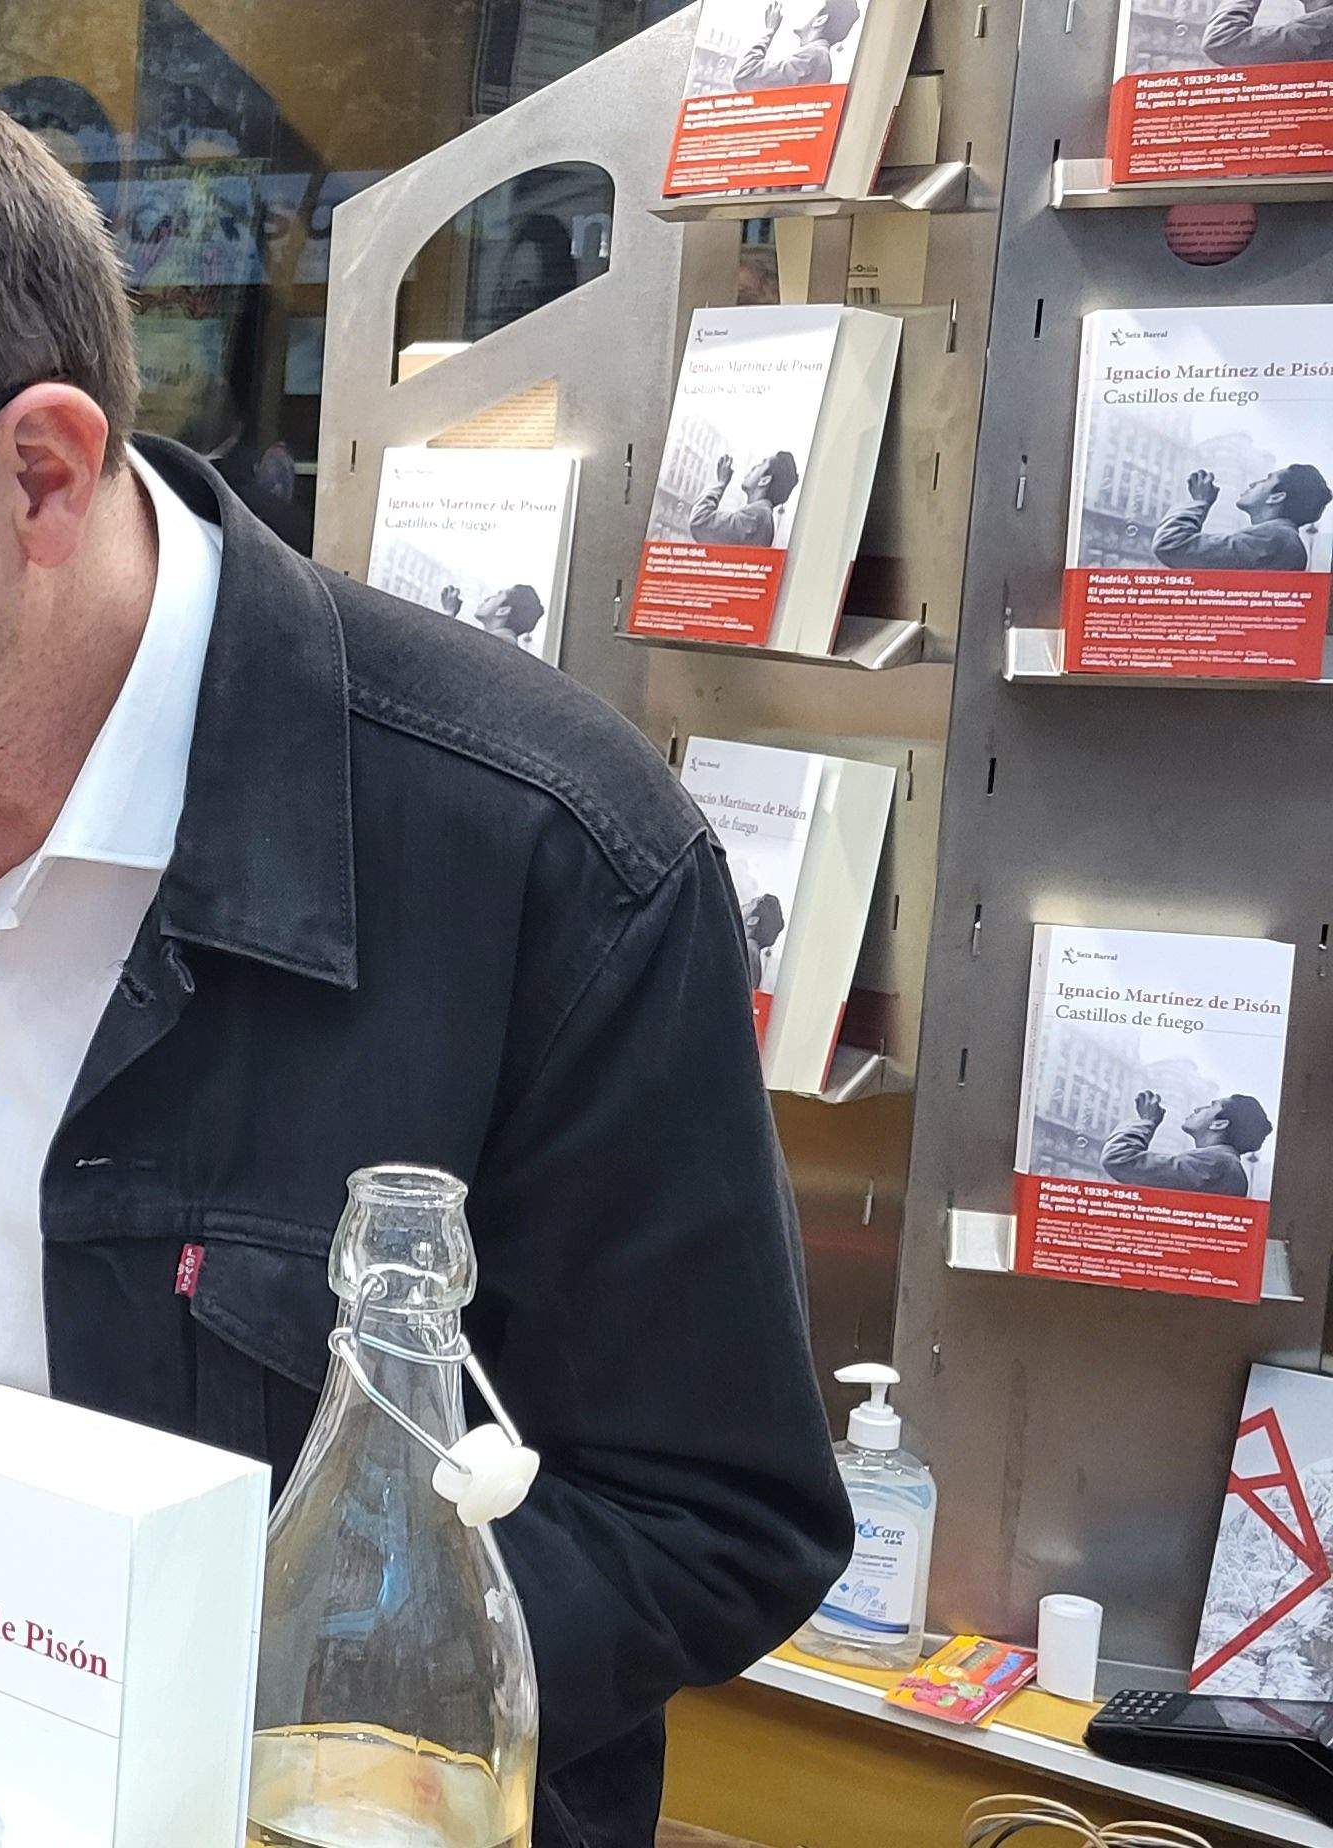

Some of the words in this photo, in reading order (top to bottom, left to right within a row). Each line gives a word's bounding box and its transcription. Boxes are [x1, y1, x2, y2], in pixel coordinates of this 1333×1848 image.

[1137, 76, 1181, 88] Madrid,
[1183, 72, 1247, 85] 1939-1945.
[1105, 366, 1171, 383] Ignacio
[1175, 363, 1258, 380] Martínez
[1263, 362, 1284, 377] de
[1103, 388, 1178, 405] Castillos
[1183, 389, 1205, 403] de
[1210, 387, 1260, 406] fuego
[1089, 574, 1131, 584] Madrid,
[1133, 576, 1194, 585] 1939-1945.
[1057, 983, 1120, 1001] Ignacio
[1125, 988, 1203, 1008] Martínez
[1208, 996, 1229, 1010] de
[1233, 998, 1282, 1015] Pisón
[1055, 1005, 1127, 1024] Castillos
[1132, 1011, 1152, 1026] de
[1157, 1013, 1204, 1034] fuego
[1041, 1182, 1081, 1195] Madrid,
[1083, 1186, 1142, 1201] 1939-1945.
[24, 1620, 109, 1680] Pisón
